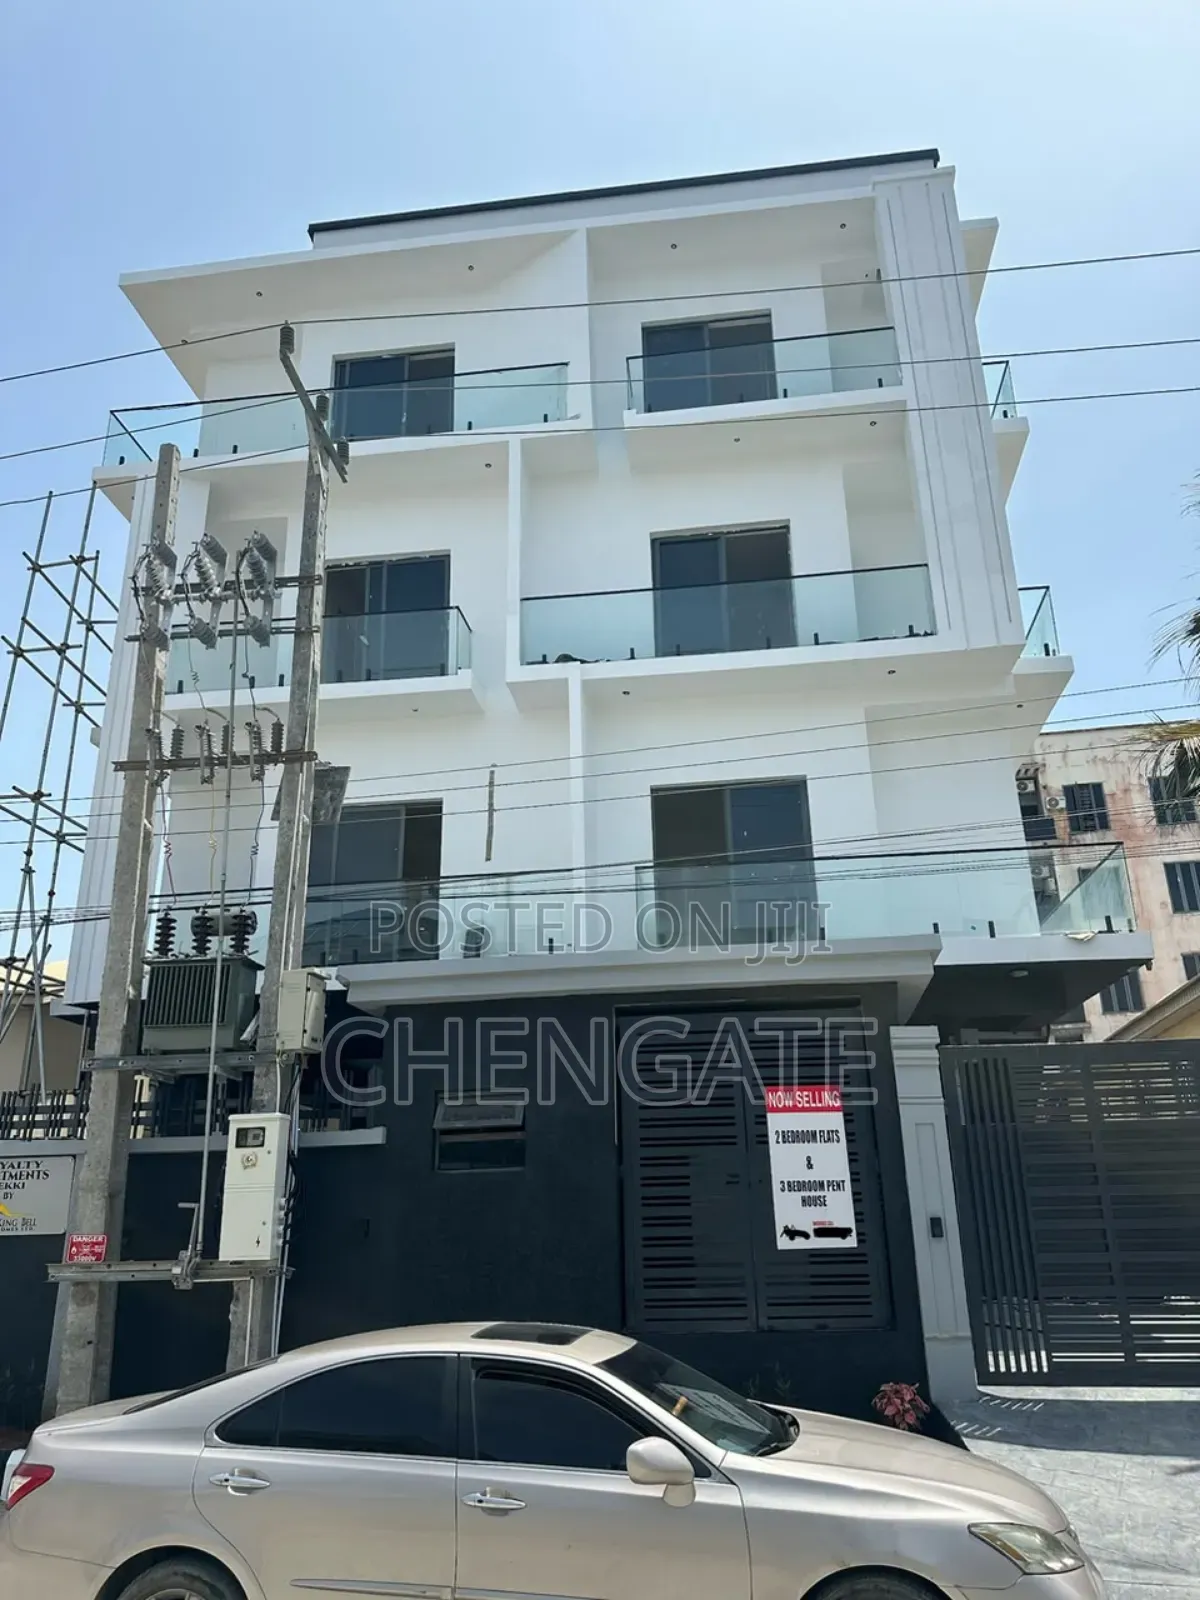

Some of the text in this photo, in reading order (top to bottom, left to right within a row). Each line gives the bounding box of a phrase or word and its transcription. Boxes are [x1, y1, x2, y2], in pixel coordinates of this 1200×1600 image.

[768, 1090, 841, 1108] NOW SELLING
[774, 1129, 841, 1144] 2 BEDROOM FLATS
[805, 1155, 814, 1170] &
[779, 1179, 846, 1193] 3 BEDROOM PENT
[3, 1191, 14, 1200] BY
[801, 1195, 828, 1208] HOUSE
